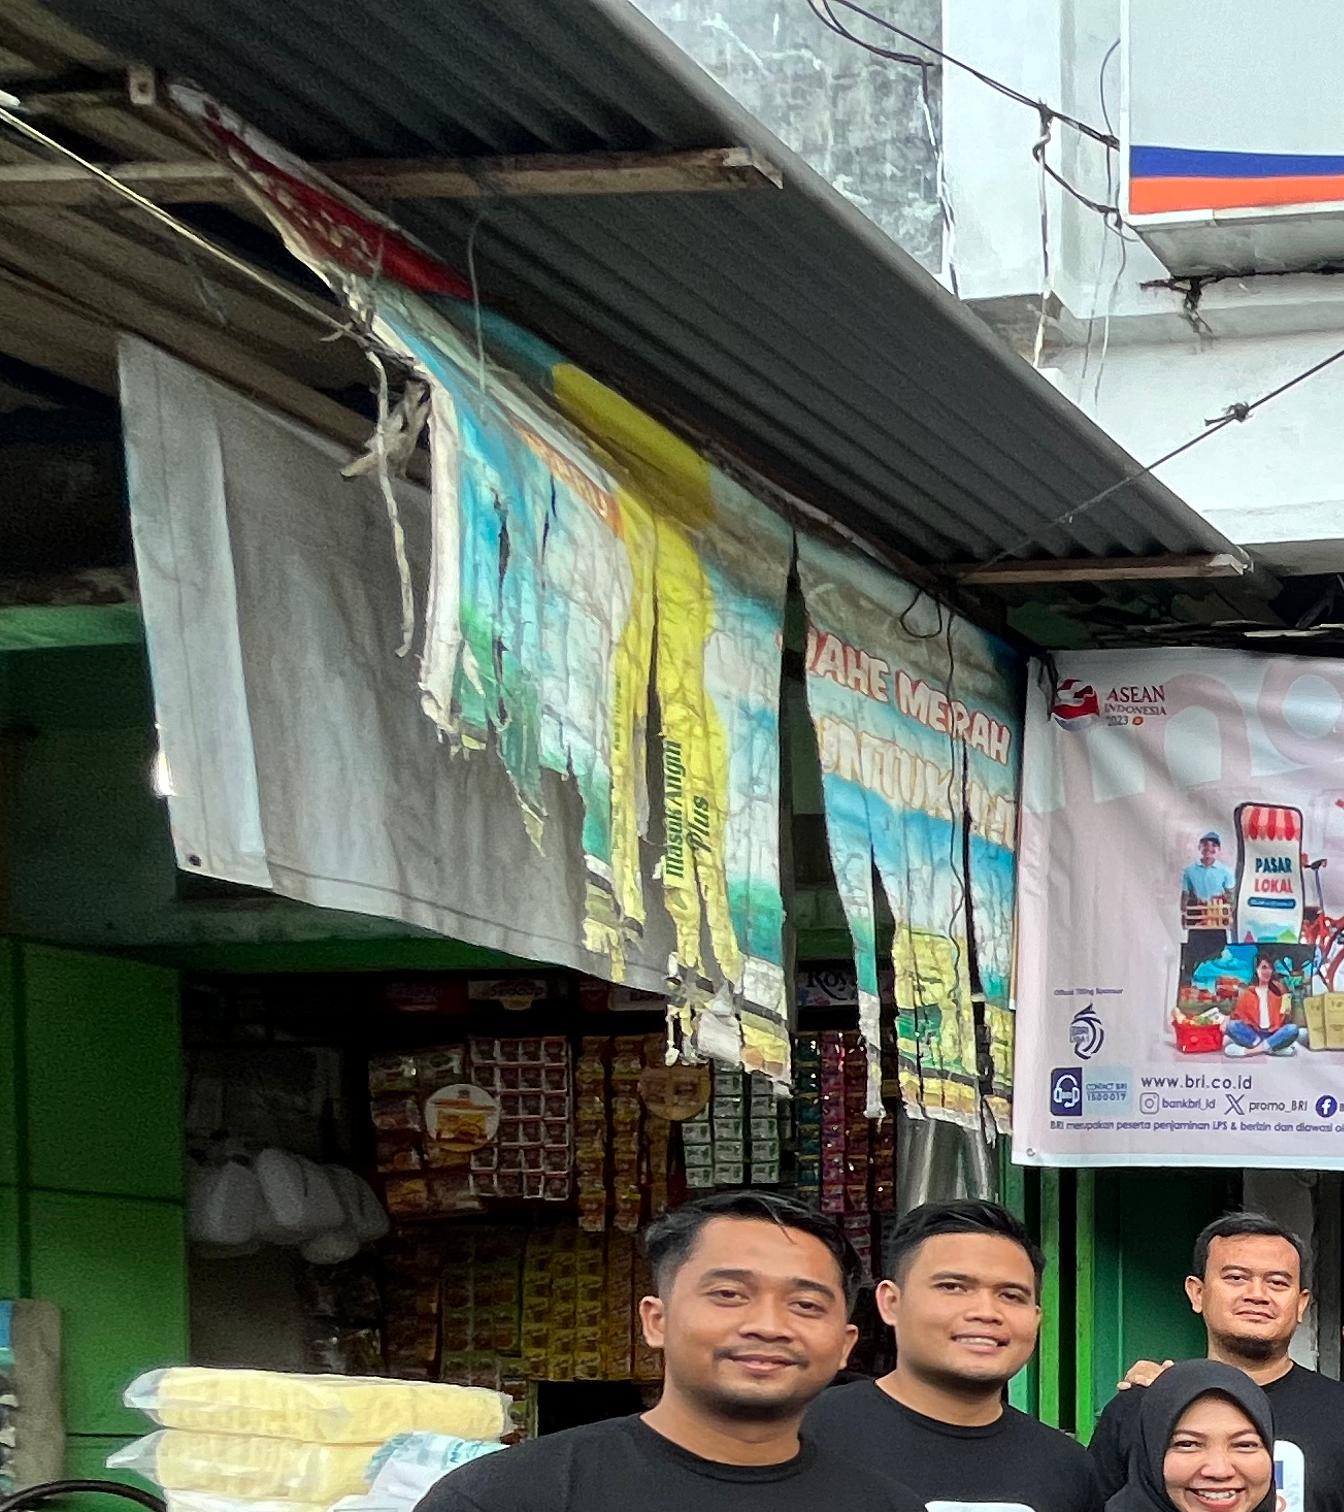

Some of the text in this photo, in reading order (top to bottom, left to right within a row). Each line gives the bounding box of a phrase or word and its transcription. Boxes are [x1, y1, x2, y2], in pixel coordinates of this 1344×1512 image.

[1106, 685, 1166, 704] ASEAN
[1103, 702, 1168, 716] INDONESIA
[895, 669, 1013, 767] MERAH
[686, 795, 712, 853] Plus
[1256, 857, 1293, 874] PASAR
[1254, 878, 1294, 894] LOKAL
[1141, 1074, 1252, 1090] www.bri.co.id
[1248, 1100, 1308, 1114] promo_BRI
[1050, 1121, 1065, 1131] BRI
[1116, 1121, 1151, 1133] peserta
[1212, 1121, 1228, 1131] LPS
[1274, 1121, 1294, 1132] dan
